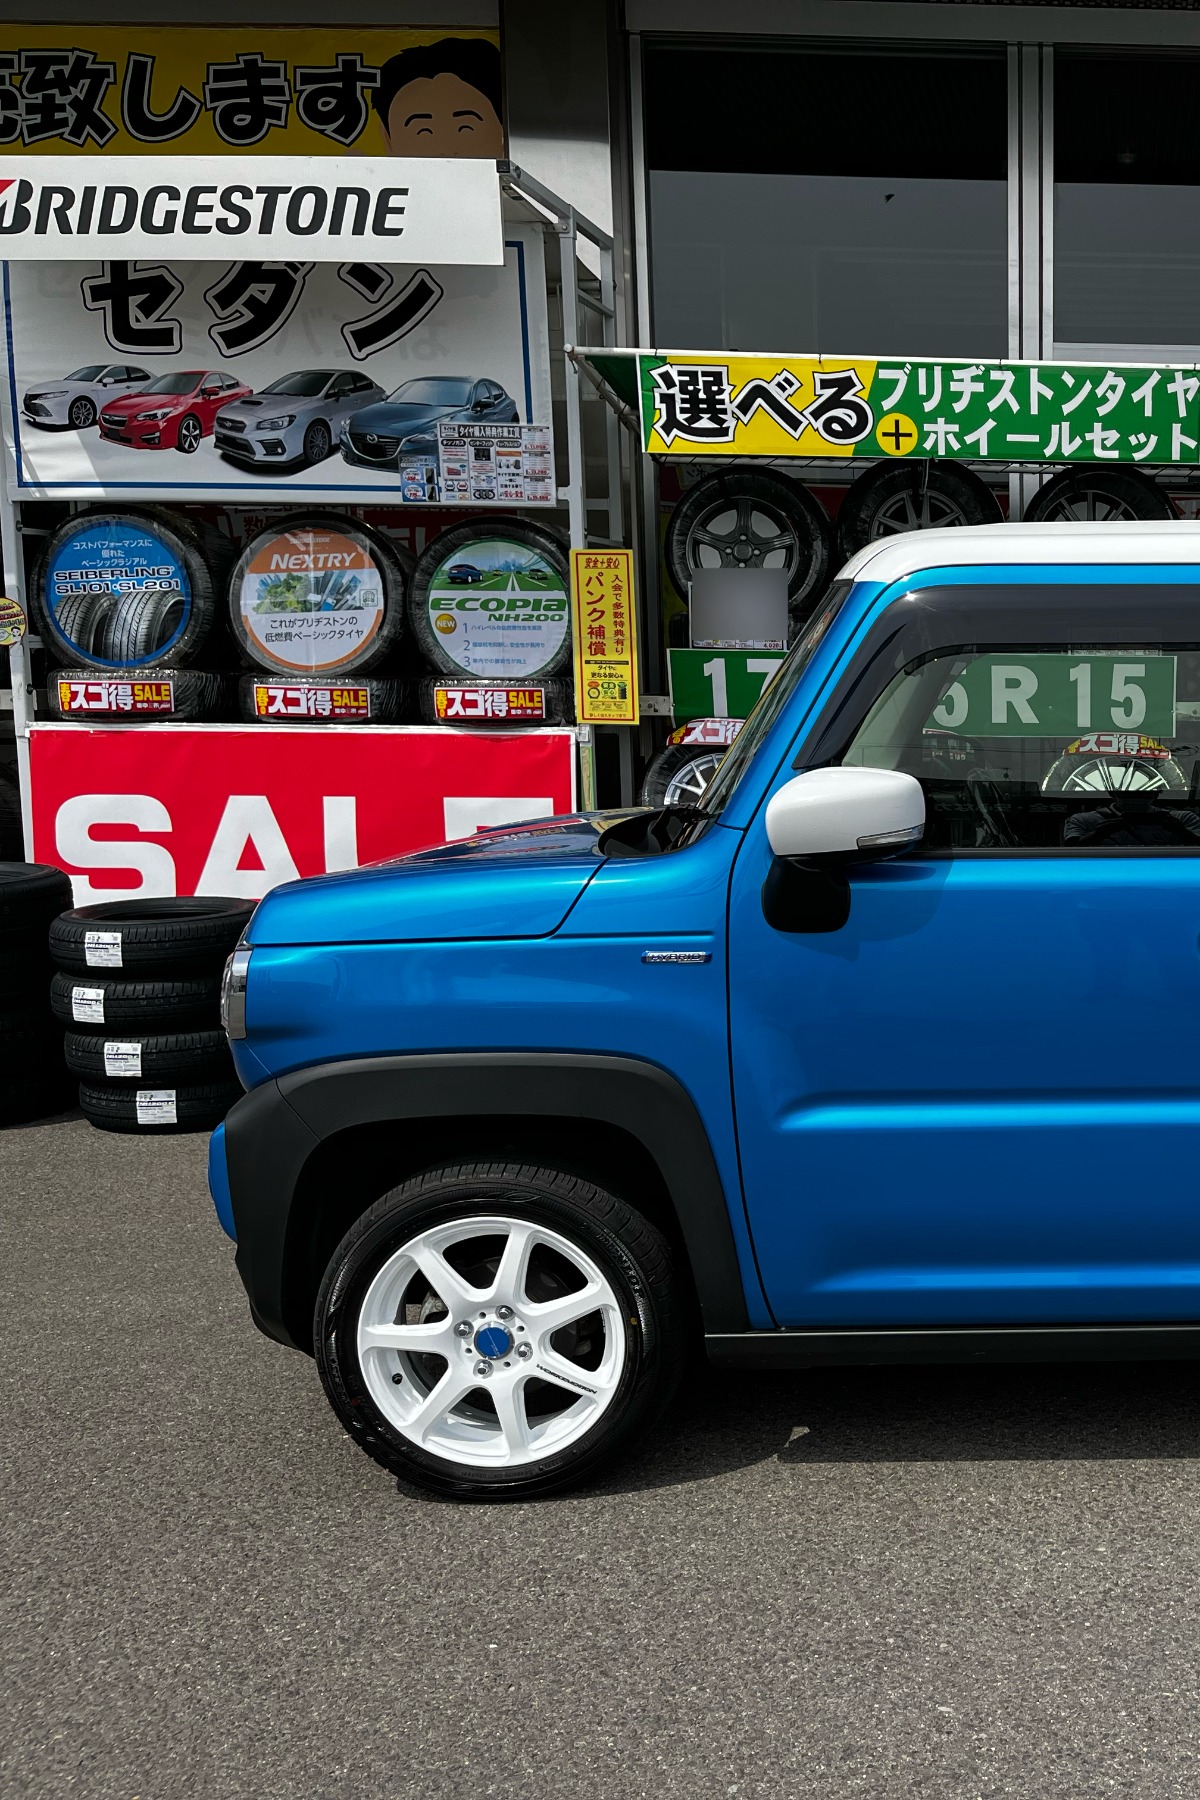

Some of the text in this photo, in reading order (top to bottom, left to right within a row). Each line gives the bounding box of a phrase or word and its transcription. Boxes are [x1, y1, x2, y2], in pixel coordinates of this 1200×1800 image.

[0, 48, 382, 148] 致します
[0, 178, 409, 238] BRIDGESTONE
[82, 260, 444, 361] セダン
[651, 362, 874, 448] 選べる
[921, 417, 1199, 462] ホイールセット
[73, 539, 153, 550] コストパフォーマンスに
[54, 566, 172, 582] SEIBERLING
[81, 557, 147, 567] ベーシックラジアル
[270, 616, 358, 629] これがブリヂストンの
[487, 613, 565, 622] NH200
[585, 572, 607, 657] パンク補償
[264, 629, 364, 643] 低燃費ベーシックタイヤ
[70, 683, 134, 710] スゴ得
[134, 684, 171, 701] SALE
[267, 688, 332, 716] スゴ得
[332, 690, 368, 707] SALE
[446, 689, 509, 717] スゴ得
[508, 691, 542, 708] SALE
[1080, 734, 1140, 755] スゴ得
[650, 953, 702, 961] HYBRID
